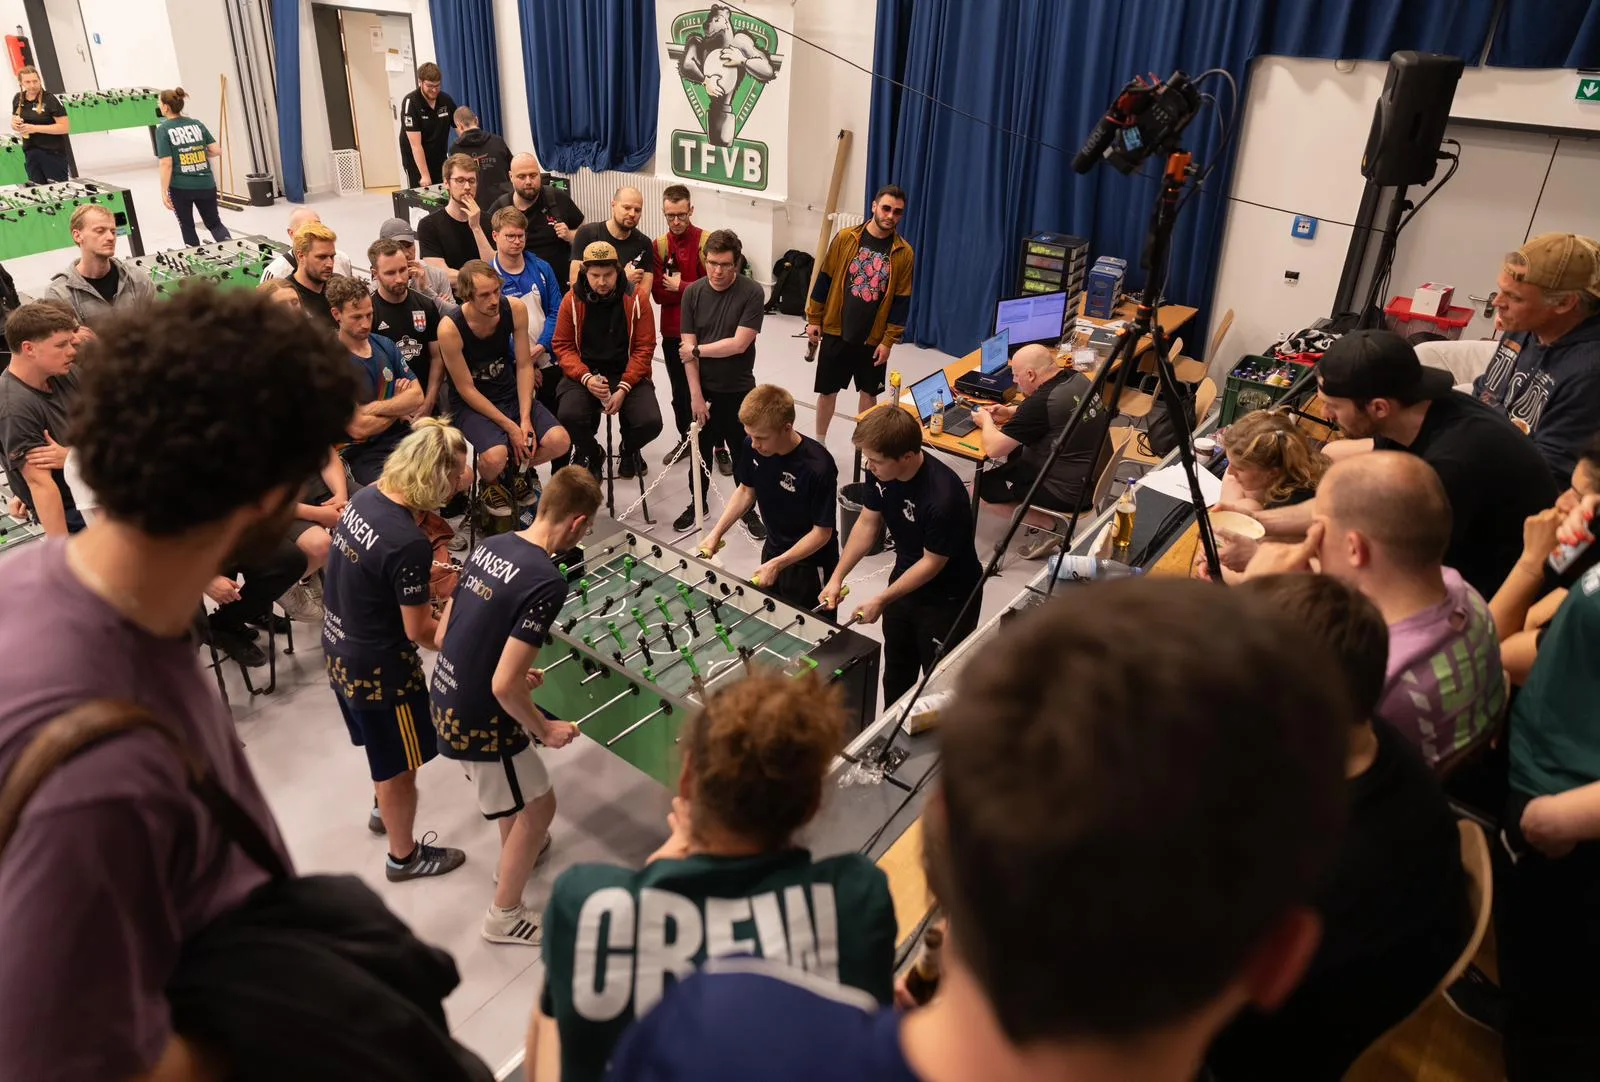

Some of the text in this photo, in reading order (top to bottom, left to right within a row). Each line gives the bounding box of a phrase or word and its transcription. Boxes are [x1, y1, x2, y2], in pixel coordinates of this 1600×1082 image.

[168, 125, 203, 146] CREW
[179, 151, 207, 165] BERLIN
[678, 138, 762, 183] TFVB
[471, 544, 521, 584] HANSEN
[572, 882, 842, 1022] CREW
